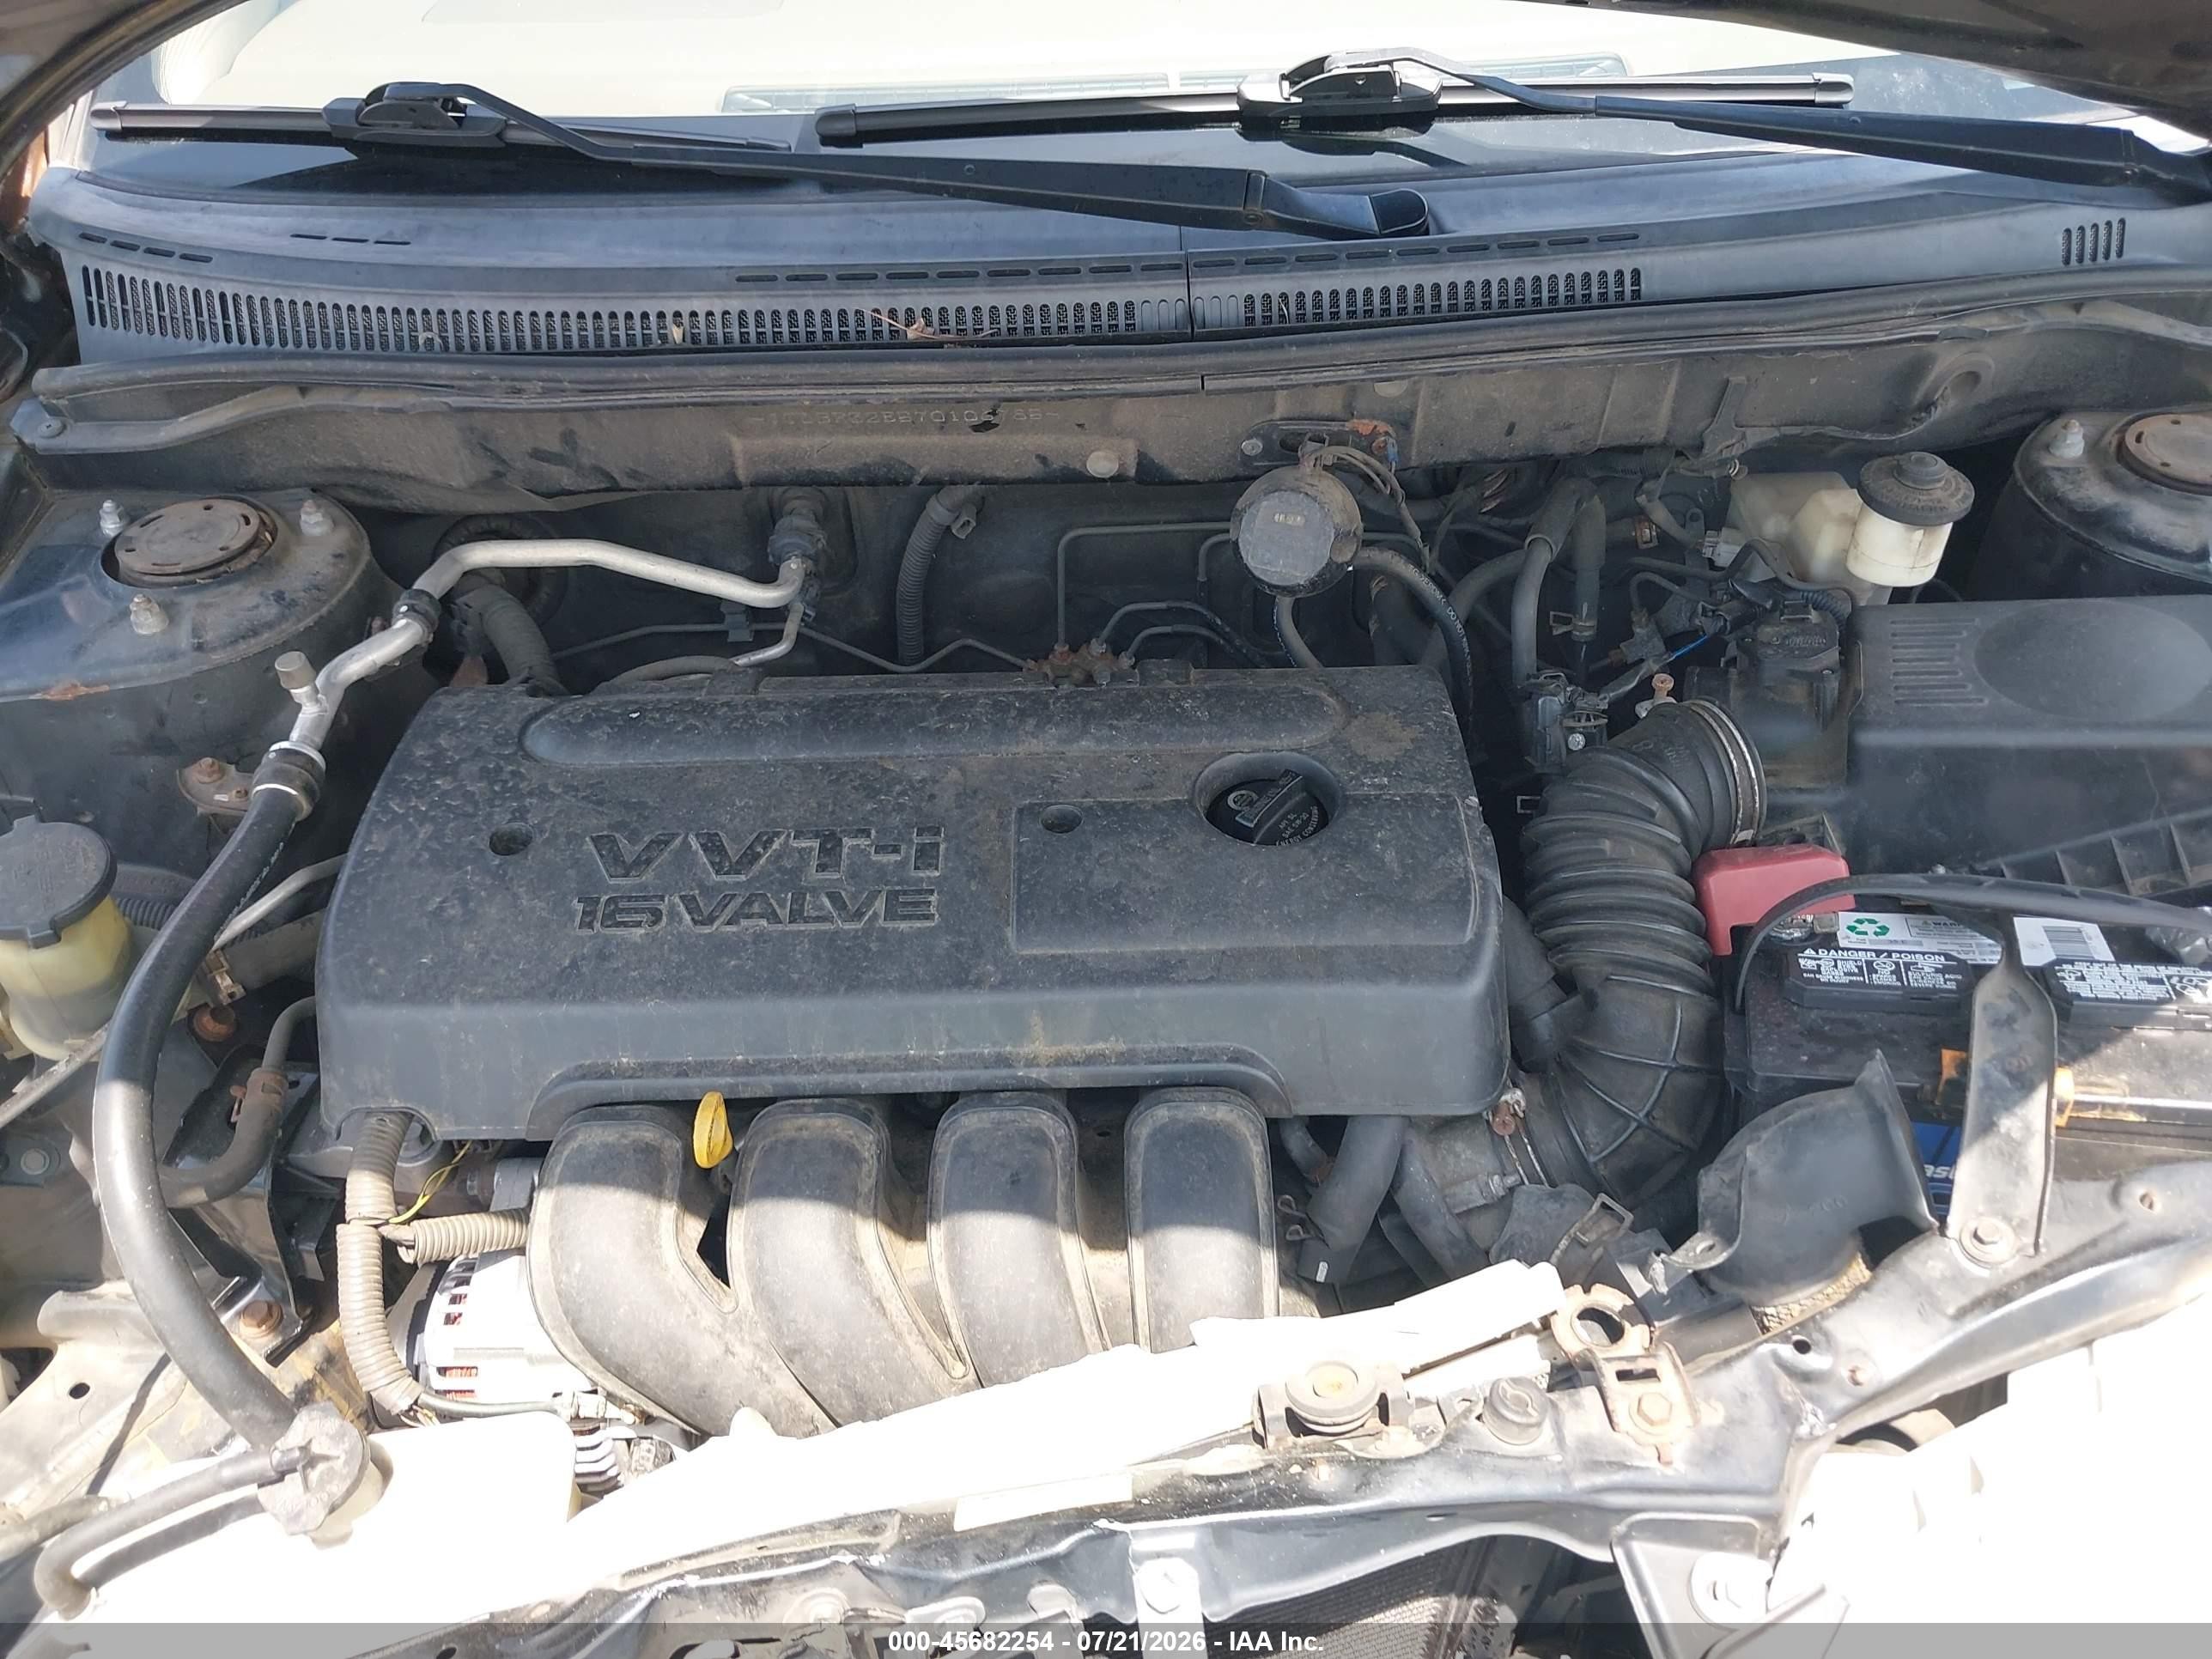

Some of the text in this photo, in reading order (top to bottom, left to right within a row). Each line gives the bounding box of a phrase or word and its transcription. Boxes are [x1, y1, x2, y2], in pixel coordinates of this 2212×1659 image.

[586, 825, 945, 884] VVT-i
[1817, 948, 1876, 958] DANGER
[1892, 952, 1946, 962] POISON
